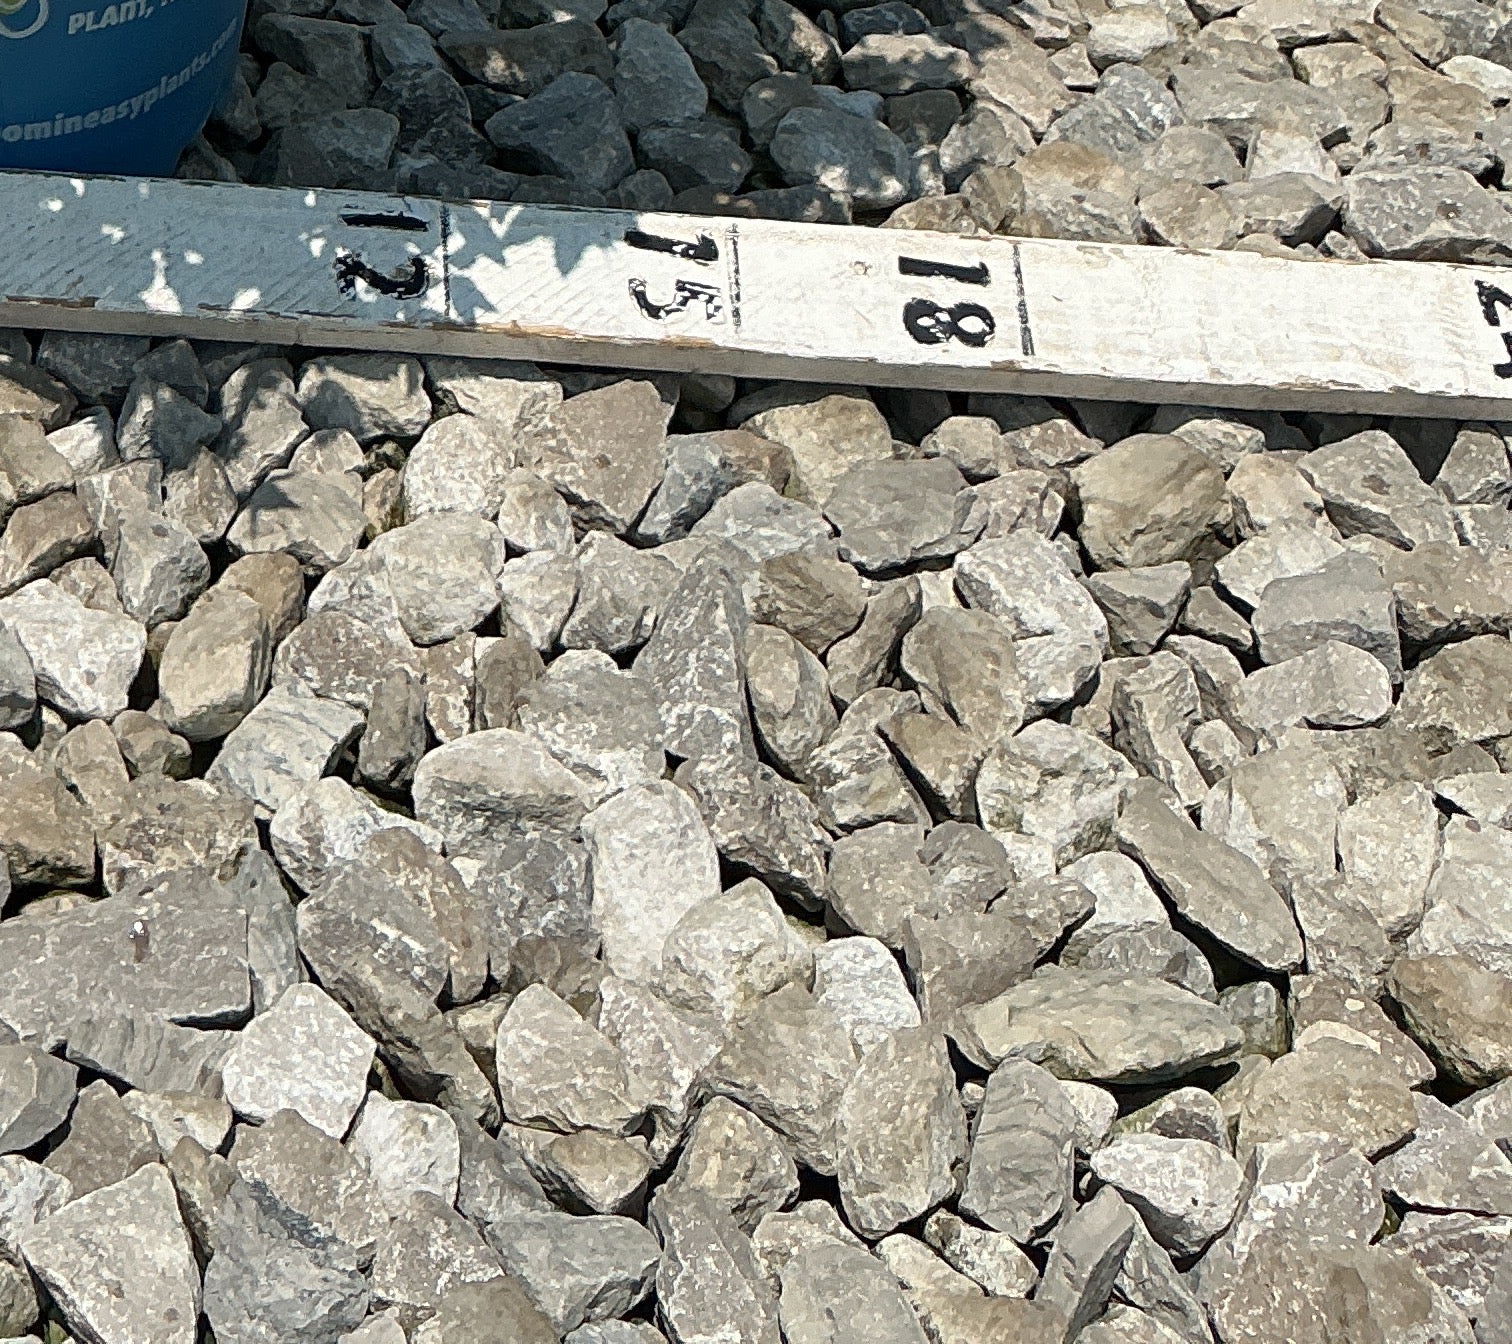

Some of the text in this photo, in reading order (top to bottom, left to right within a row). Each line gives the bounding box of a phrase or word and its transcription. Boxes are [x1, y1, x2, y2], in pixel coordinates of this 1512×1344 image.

[335, 210, 430, 301] 12
[624, 228, 722, 323] 15
[898, 255, 996, 348] 18
